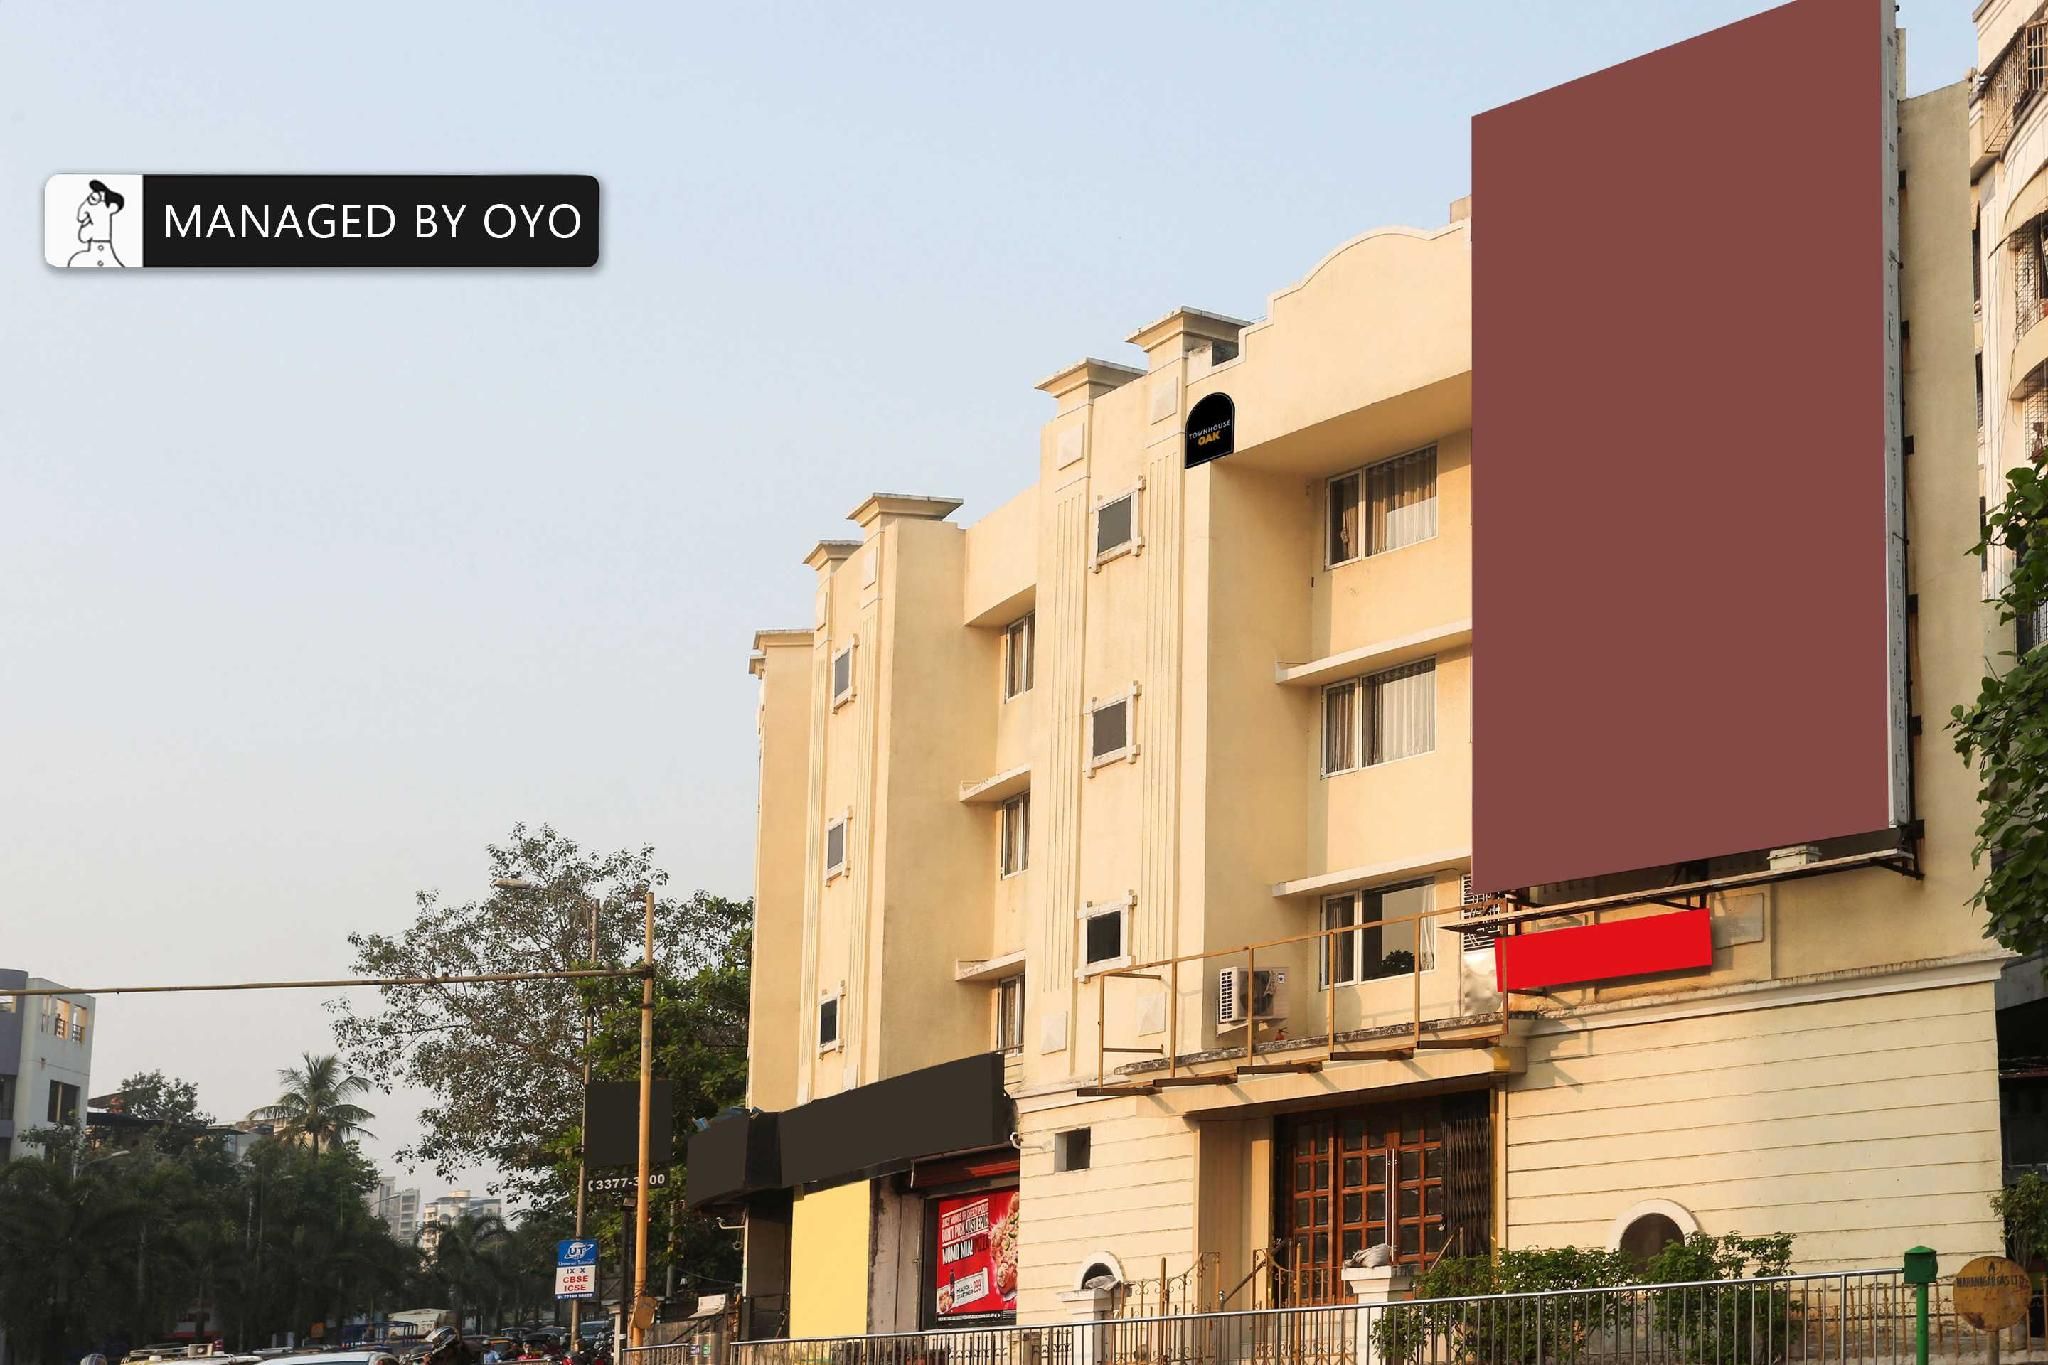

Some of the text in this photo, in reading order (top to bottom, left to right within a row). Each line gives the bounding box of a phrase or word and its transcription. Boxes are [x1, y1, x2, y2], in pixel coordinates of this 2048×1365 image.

[1189, 419, 1231, 440] TOWNHOUSE
[1198, 431, 1221, 446] OAK
[596, 1173, 665, 1190] 3377-300
[570, 1247, 585, 1256] UT
[563, 1275, 588, 1284] CBSE
[564, 1284, 587, 1292] ICSE
